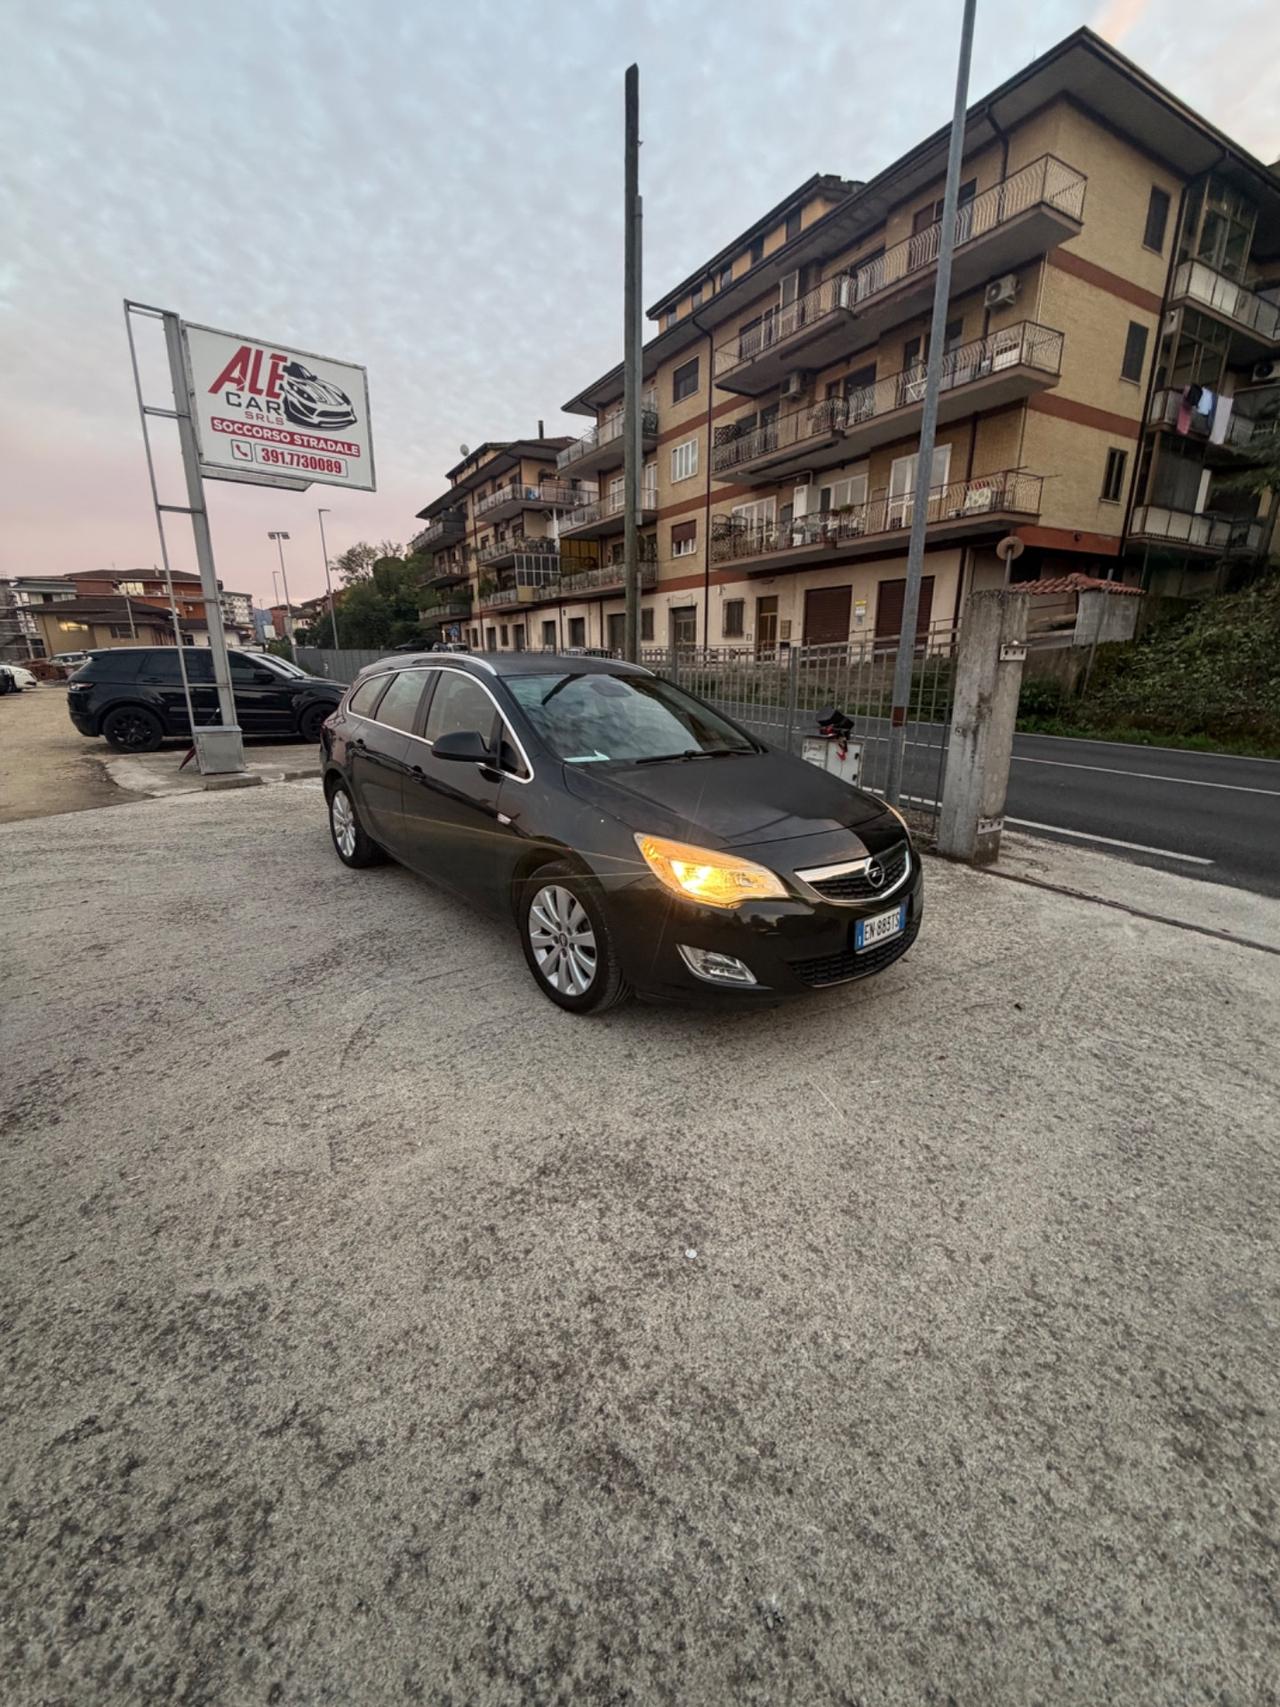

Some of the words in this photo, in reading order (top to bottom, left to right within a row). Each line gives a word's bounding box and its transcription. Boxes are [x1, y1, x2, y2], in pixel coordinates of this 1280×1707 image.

[208, 345, 288, 399] ALE
[225, 391, 283, 416] CAR
[244, 410, 285, 426] SRLS
[213, 419, 291, 443] SOCCORSO
[294, 435, 360, 456] STRADALE
[261, 447, 342, 474] 391.7730089
